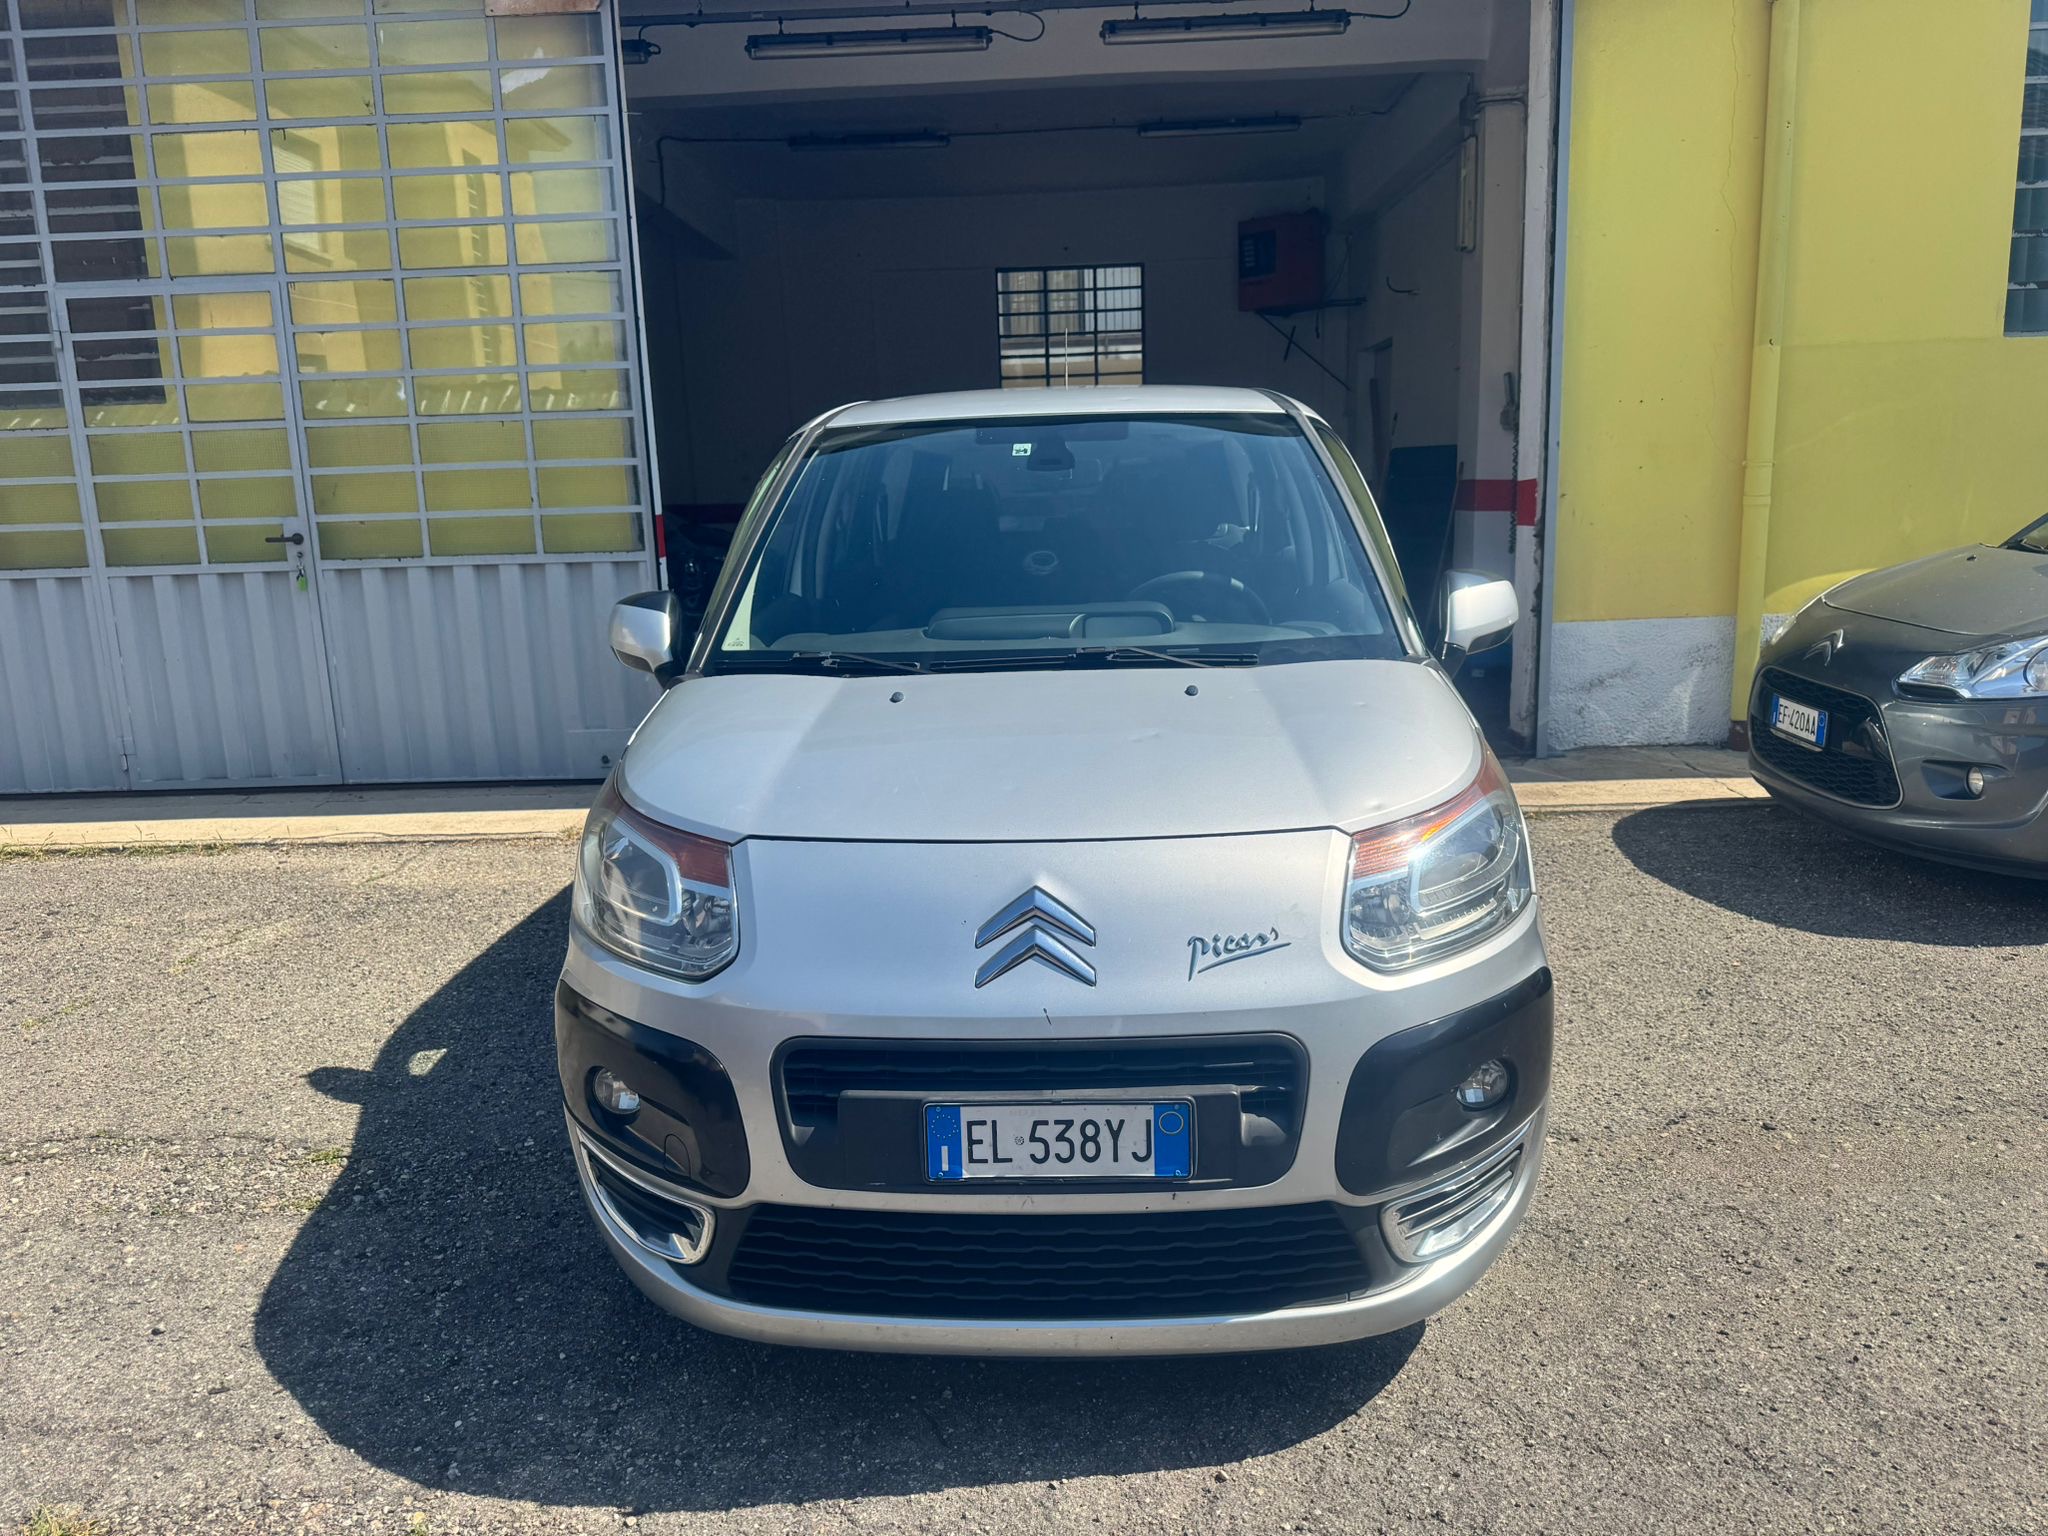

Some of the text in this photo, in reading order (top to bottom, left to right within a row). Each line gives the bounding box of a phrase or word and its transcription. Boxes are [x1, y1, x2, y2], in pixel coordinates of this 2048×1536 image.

[1789, 709, 1816, 735] 420AA
[966, 1119, 1013, 1164] EL
[1029, 1118, 1152, 1164] 538YJ
